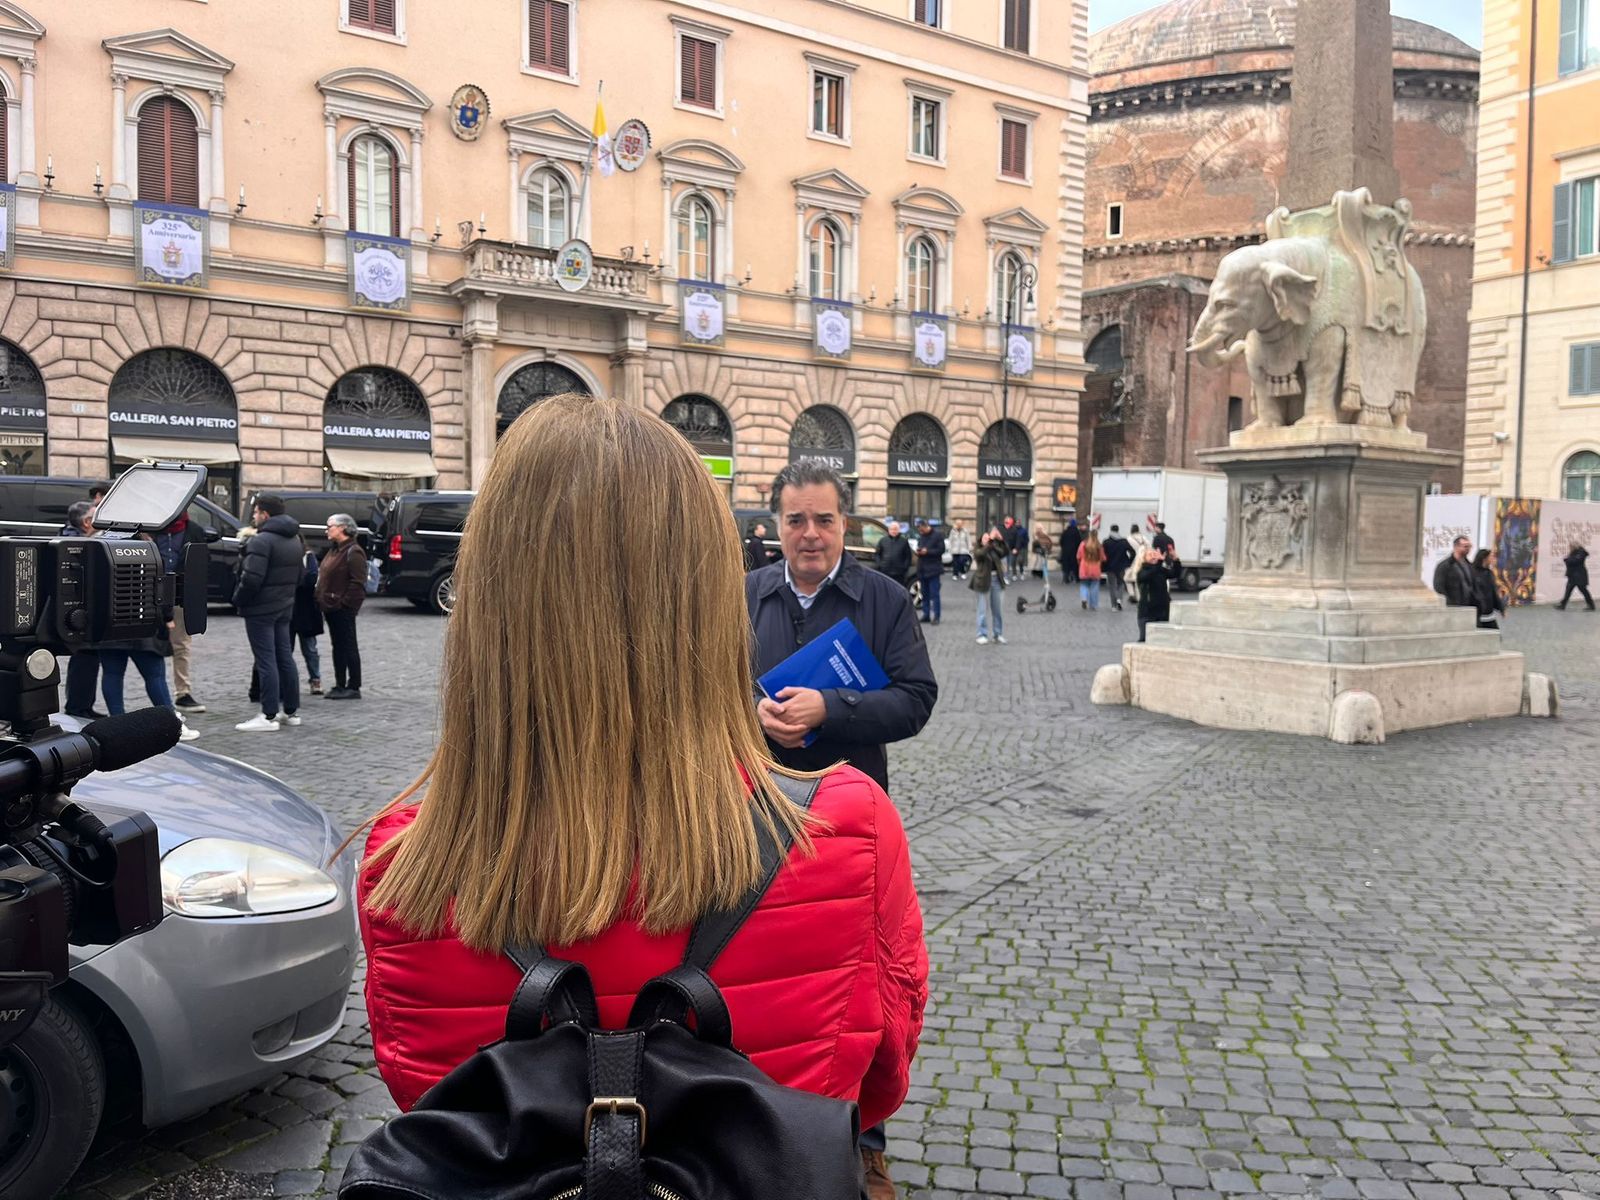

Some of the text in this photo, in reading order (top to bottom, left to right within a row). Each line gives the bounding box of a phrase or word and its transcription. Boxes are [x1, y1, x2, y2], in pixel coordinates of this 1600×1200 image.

[109, 412, 237, 429] GALLERIA SAN PIETRO
[324, 425, 431, 440] GALLERIA SAN PIETRO
[799, 454, 844, 469] BRNES
[897, 459, 938, 473] BARNES
[115, 548, 148, 556] SONY
